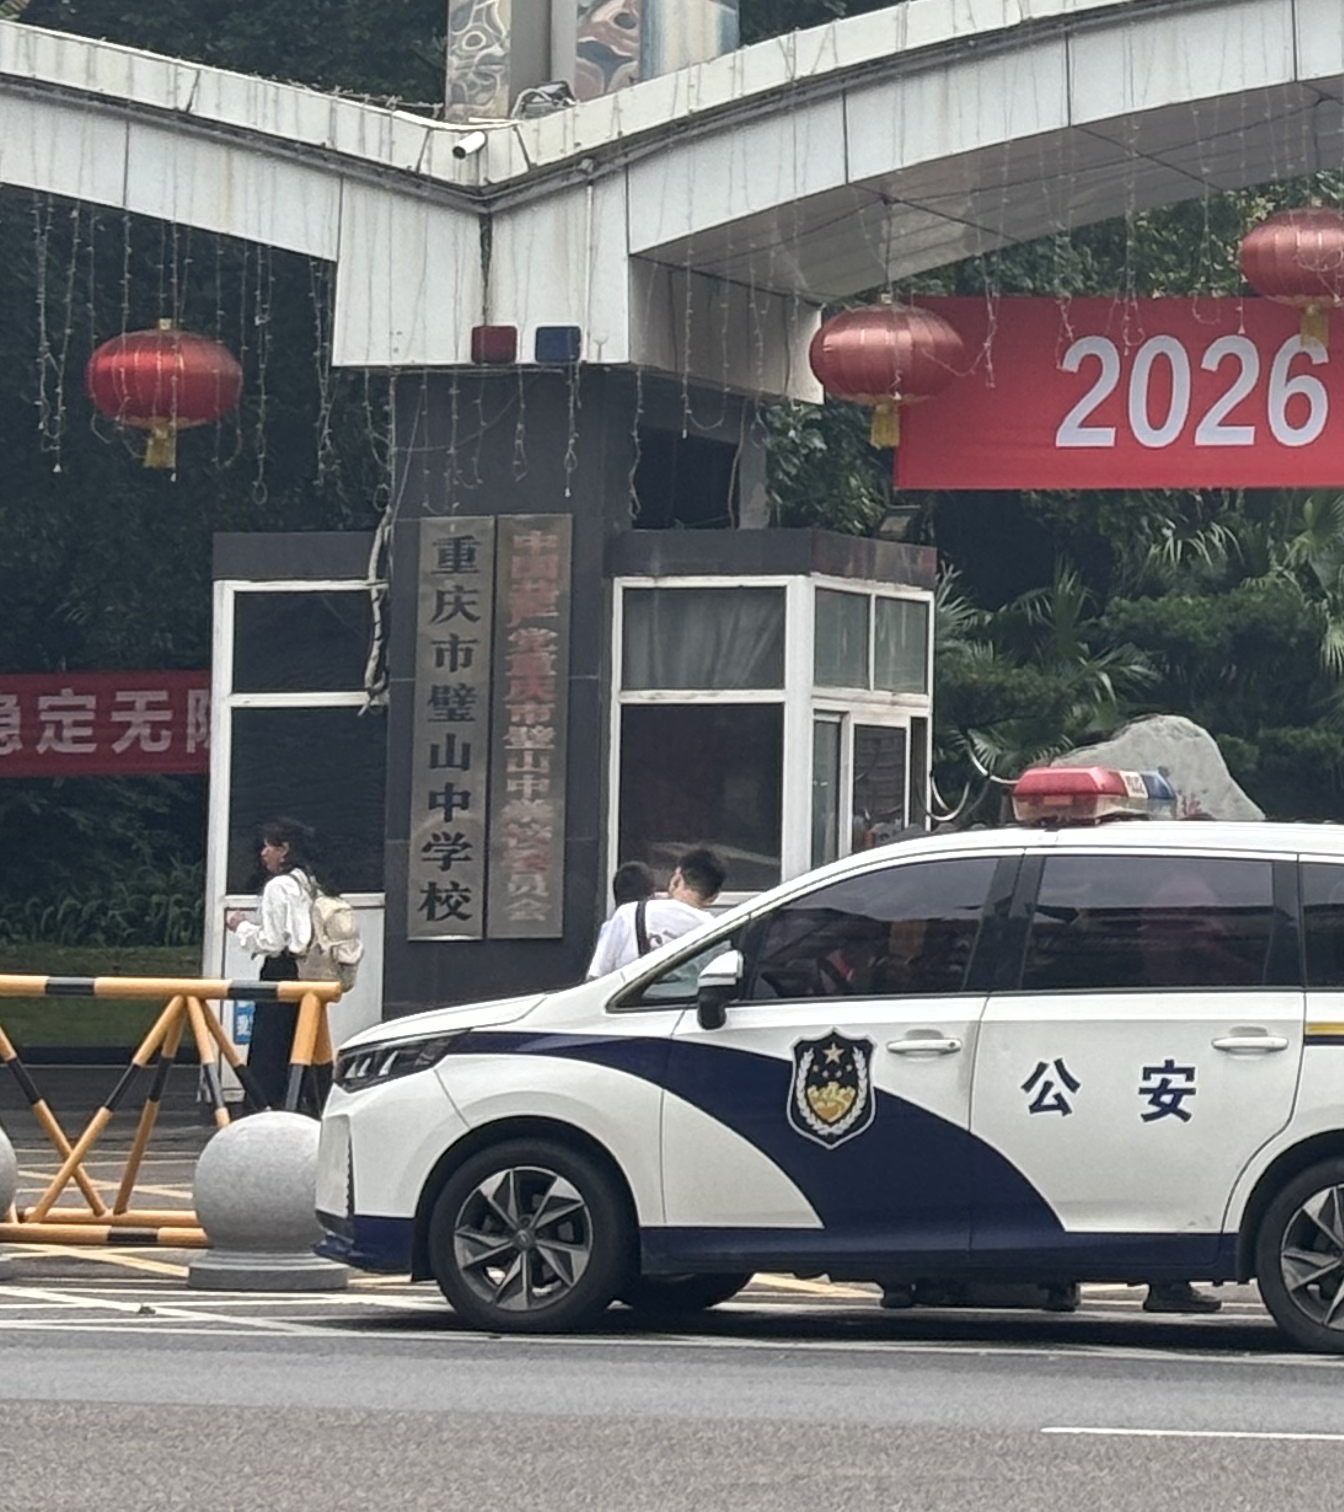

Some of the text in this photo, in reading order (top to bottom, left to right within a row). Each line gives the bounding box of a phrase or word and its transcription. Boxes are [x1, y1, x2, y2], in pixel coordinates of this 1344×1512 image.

[417, 534, 482, 922] 重庆市璧山中学校
[1020, 1058, 1197, 1123] 公安
